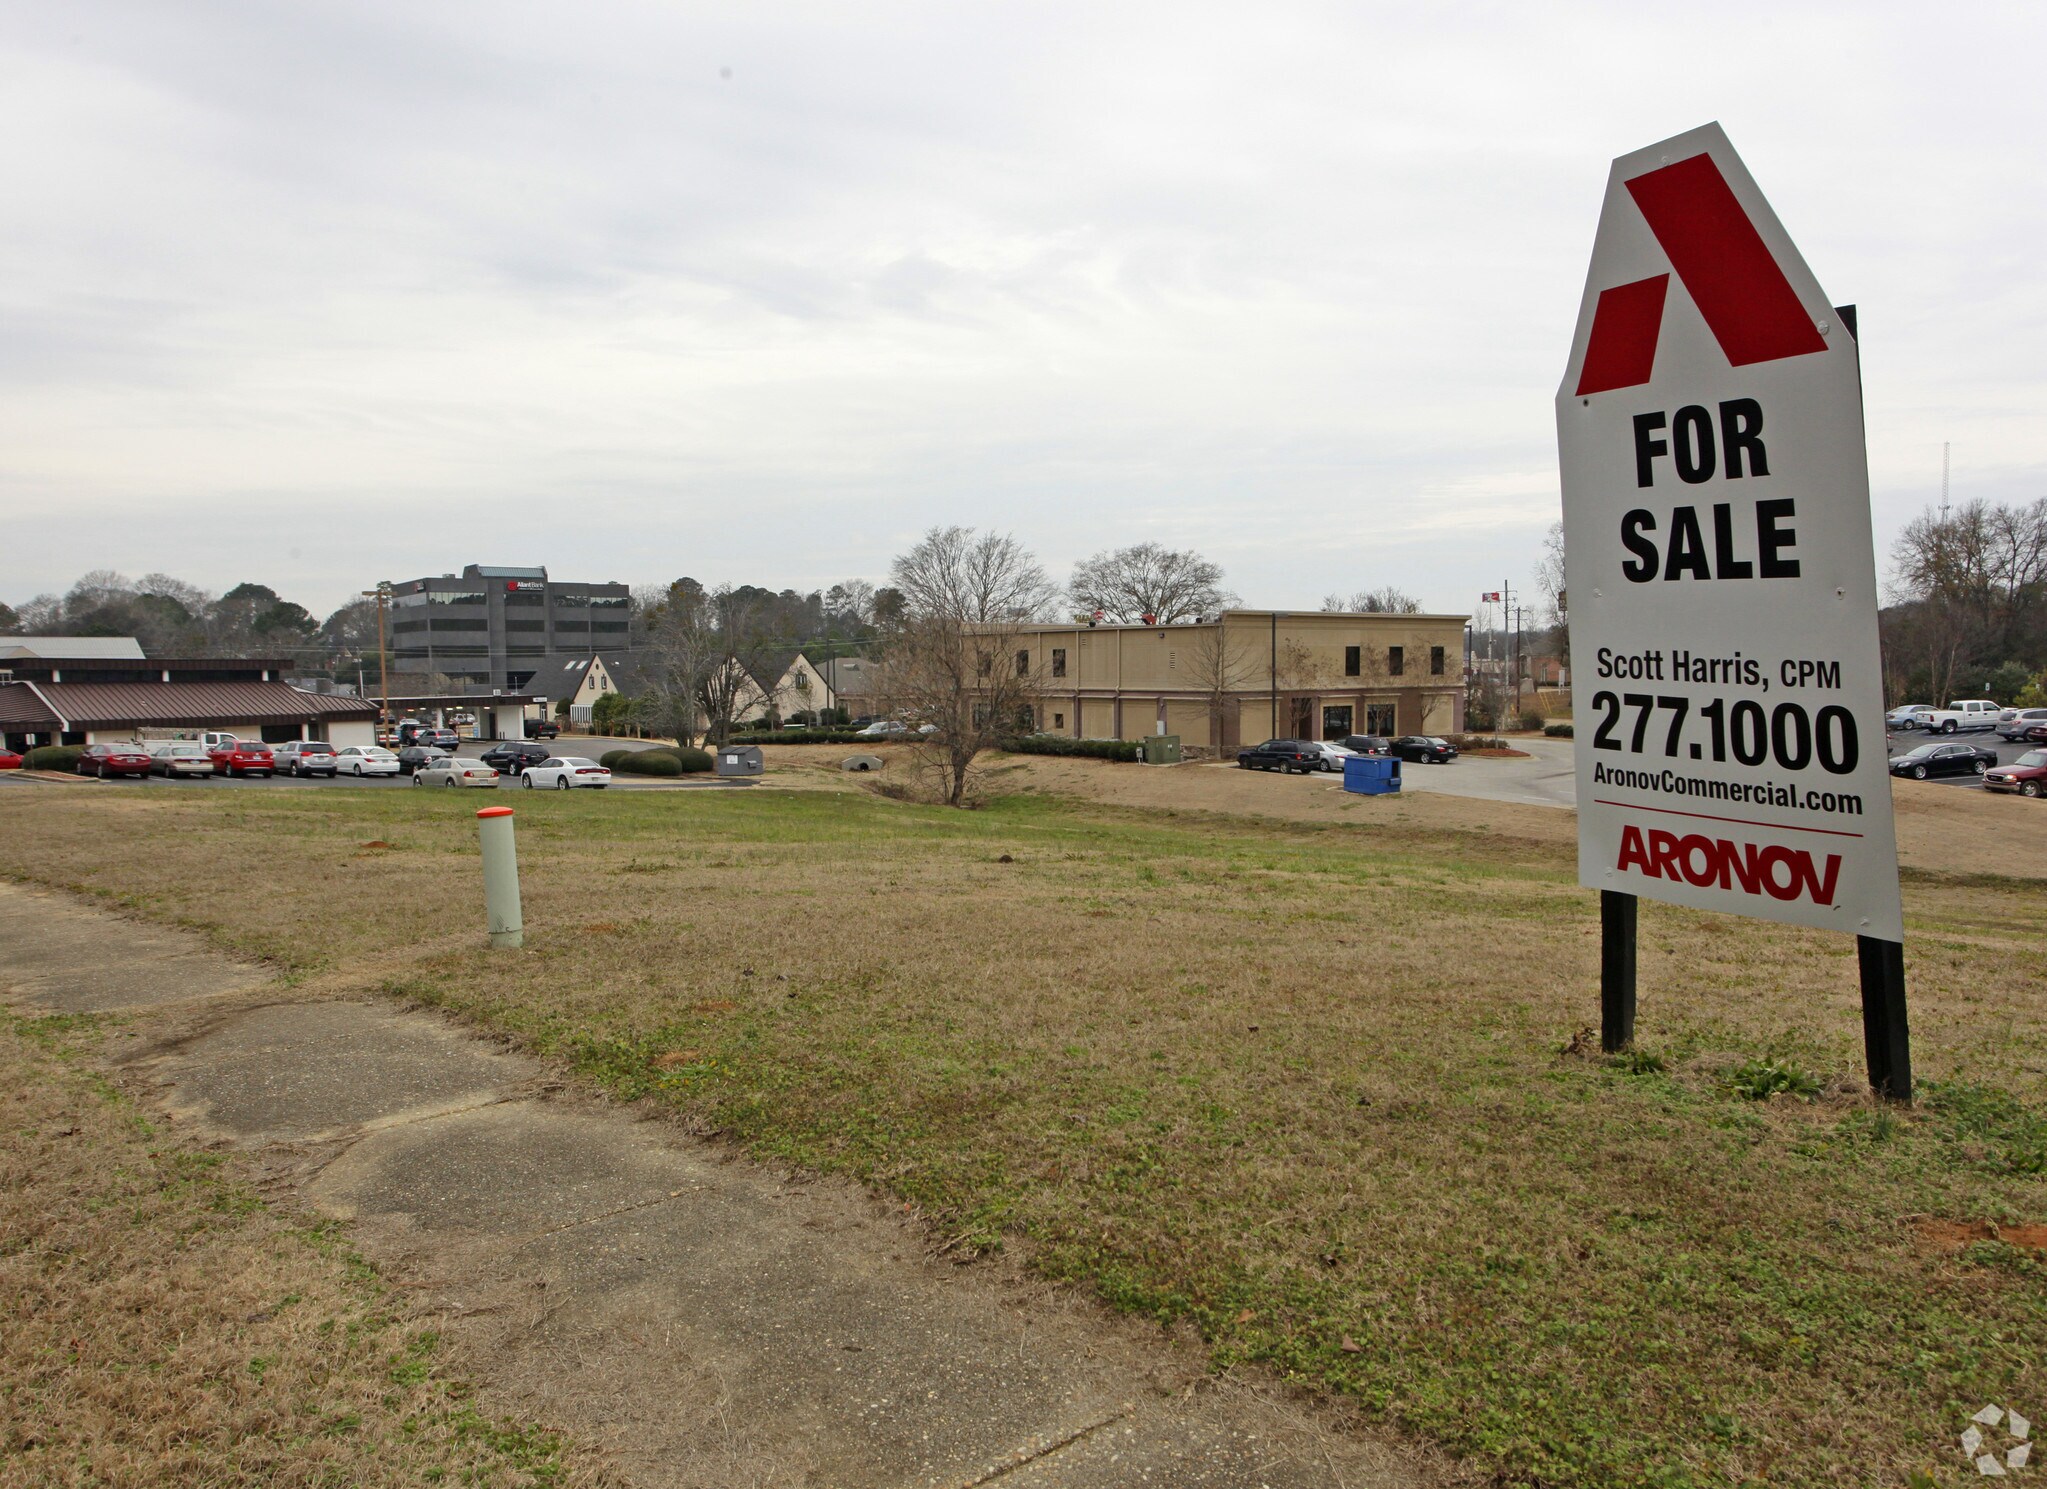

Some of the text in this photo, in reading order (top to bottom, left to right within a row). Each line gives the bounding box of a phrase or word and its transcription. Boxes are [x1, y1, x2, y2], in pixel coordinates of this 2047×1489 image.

[1632, 397, 1772, 489] FOR
[1620, 497, 1802, 584] SALE
[1597, 647, 1842, 694] Scott Harris, CPM
[1591, 690, 1860, 776] 277.1000
[1593, 761, 1864, 816] AronovCommercial.com
[1617, 825, 1841, 905] ARONOV
